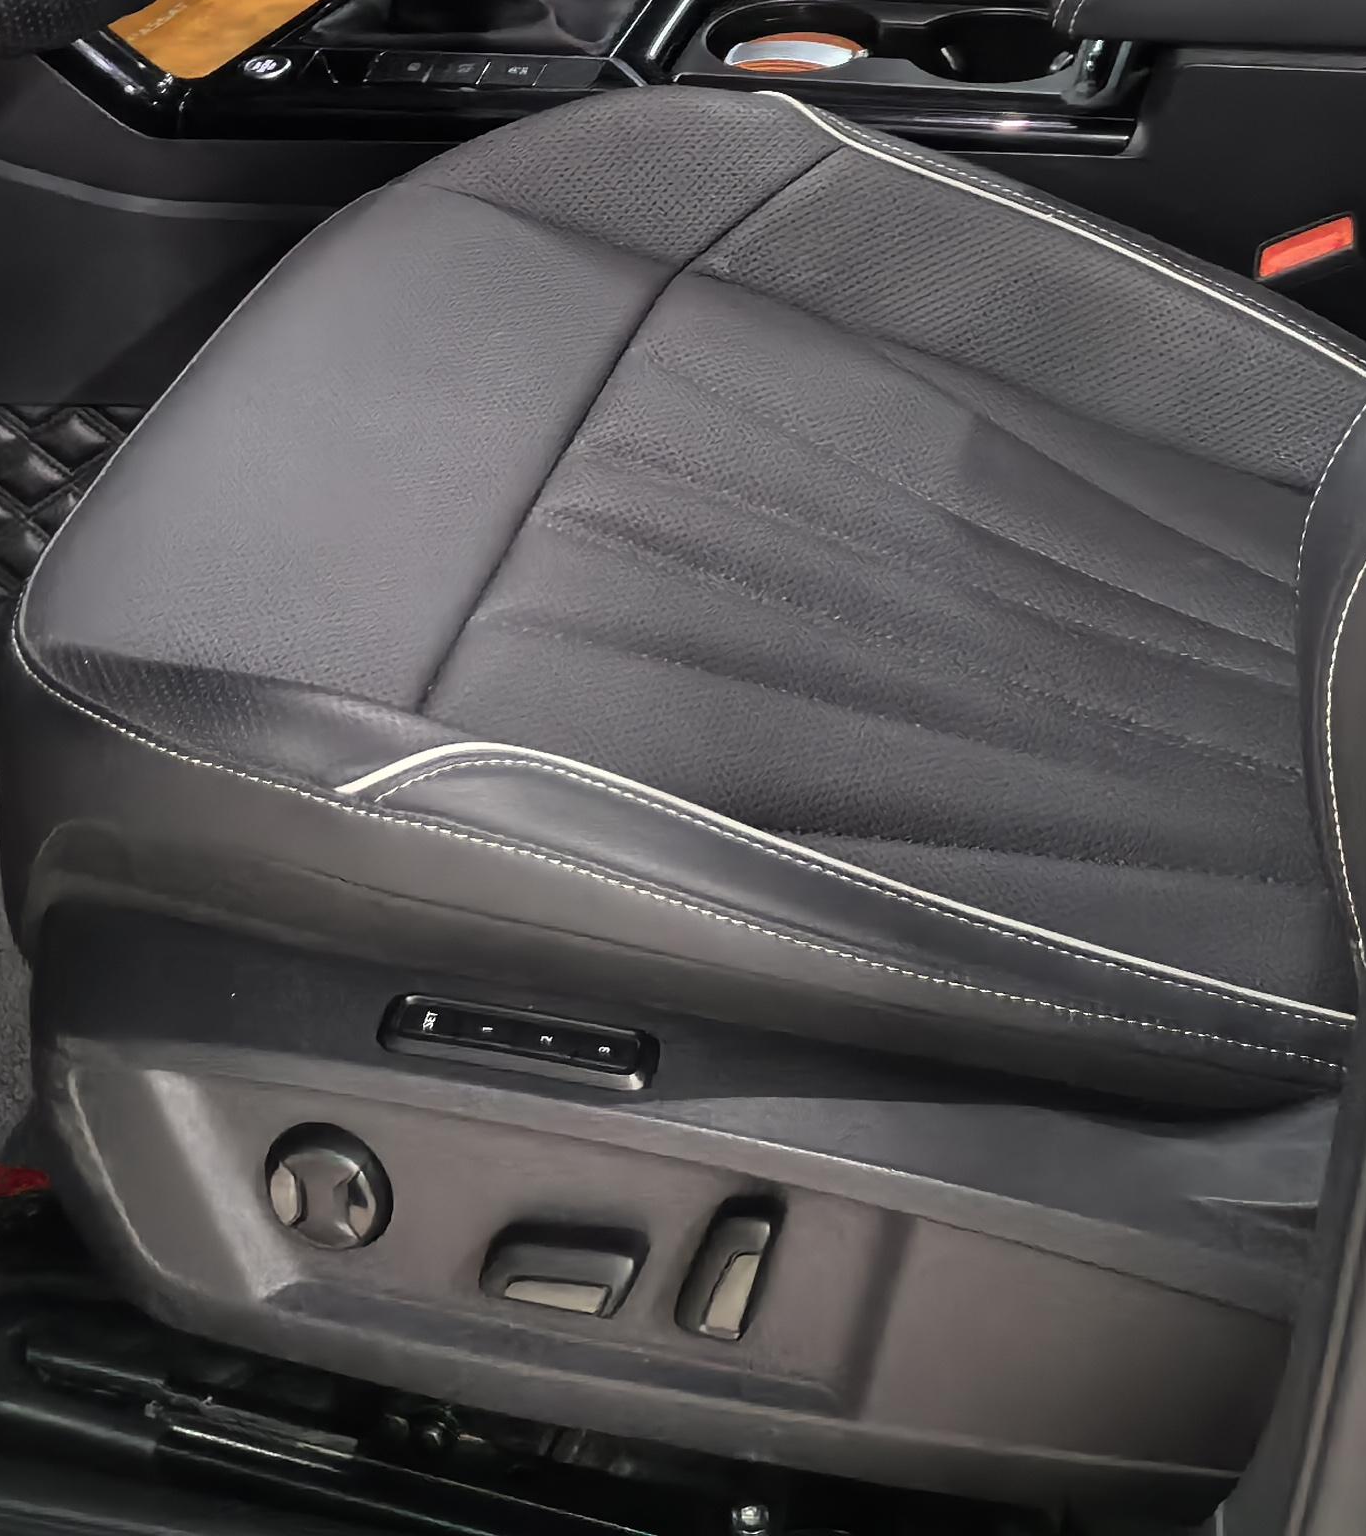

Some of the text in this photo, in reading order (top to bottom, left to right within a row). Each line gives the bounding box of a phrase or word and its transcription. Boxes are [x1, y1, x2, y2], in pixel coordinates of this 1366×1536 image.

[423, 1011, 438, 1031] SET
[540, 1035, 554, 1044] 2
[598, 1046, 611, 1055] 3
